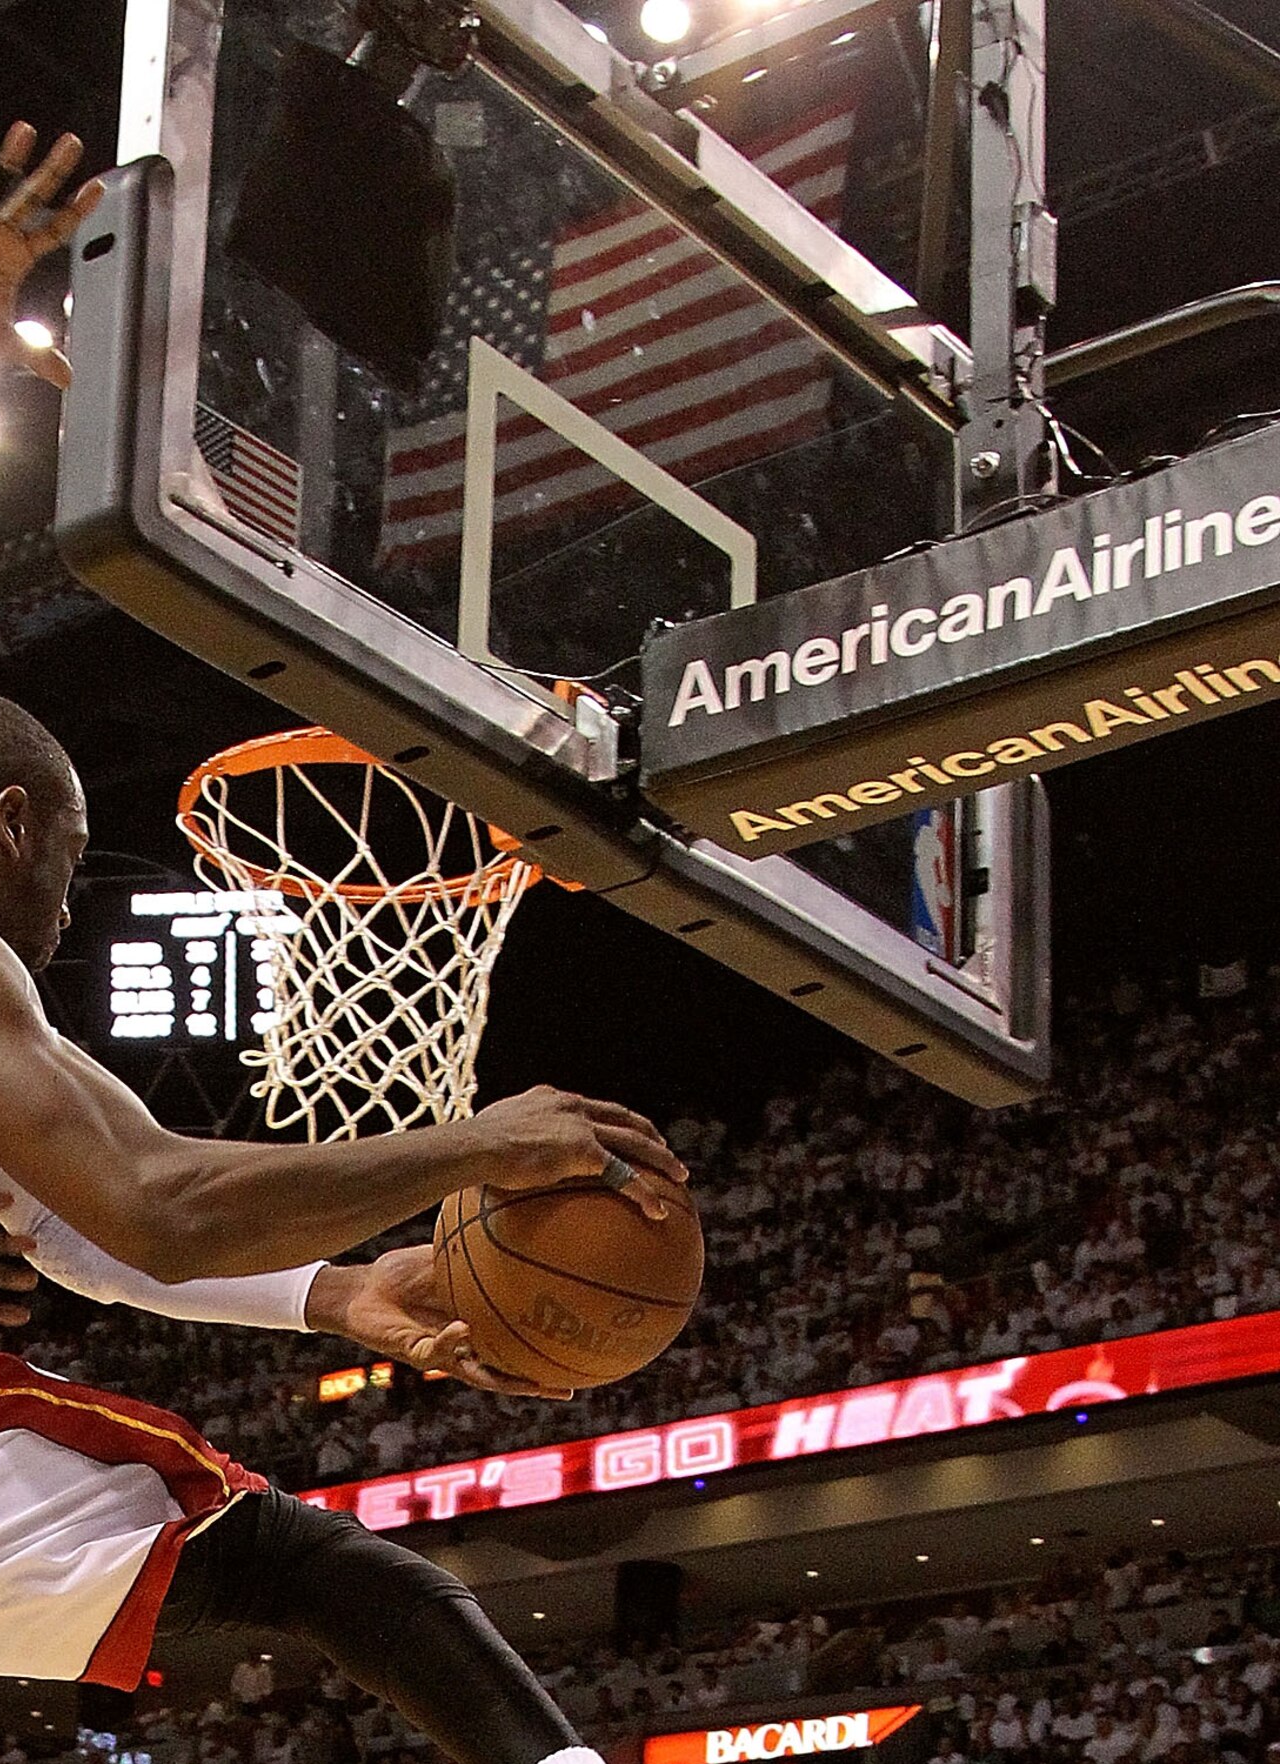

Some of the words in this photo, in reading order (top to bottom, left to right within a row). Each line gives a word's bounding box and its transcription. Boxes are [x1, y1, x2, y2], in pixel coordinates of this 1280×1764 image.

[667, 495, 1280, 727] AmericanAirline
[729, 659, 1280, 842] AmericanAirlin
[307, 1453, 564, 1531] ET'S
[594, 1420, 734, 1492] GO
[705, 1713, 873, 1764] BACARDI
